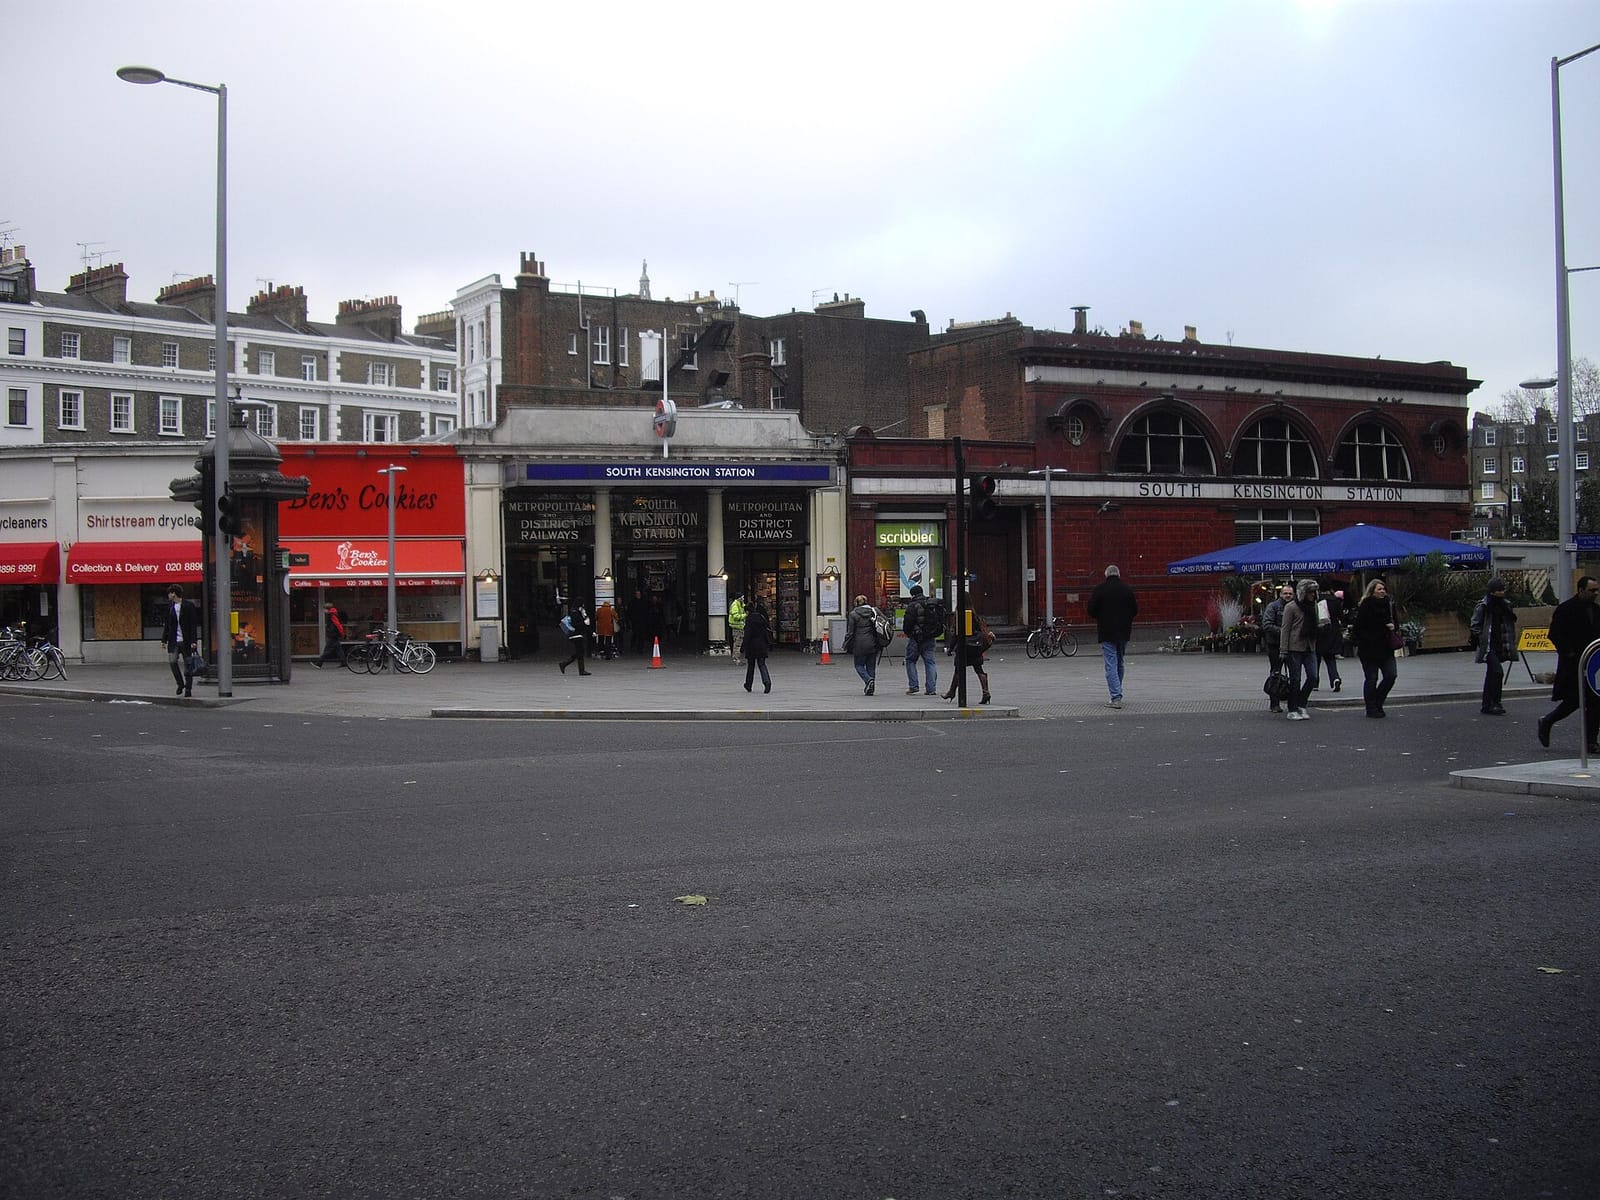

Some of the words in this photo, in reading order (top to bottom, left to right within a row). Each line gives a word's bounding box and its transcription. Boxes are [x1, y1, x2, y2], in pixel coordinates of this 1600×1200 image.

[606, 468, 642, 476] SOUTH
[646, 468, 710, 477] KENSINGTON
[715, 468, 754, 477] STATION
[1139, 482, 1200, 496] SOUTH
[1233, 484, 1322, 499] KENSINGTON
[1347, 488, 1402, 500] STATION
[509, 502, 594, 512] METROPOLITAN
[640, 499, 676, 510] SOUTH
[728, 503, 802, 512] METROPOLITAN
[87, 515, 155, 528] Shirtstream
[620, 512, 698, 526] KENSINGTON
[740, 520, 792, 528] DISTRICT
[520, 520, 578, 529] DISTRICT
[520, 530, 579, 540] RAILWAYS
[632, 528, 684, 539] STATION
[740, 530, 792, 539] RAILWAYS
[880, 528, 934, 544] scribbler
[350, 550, 378, 559] Ben's
[351, 558, 388, 566] Cookies
[1242, 564, 1263, 572] QUALITY
[1266, 563, 1290, 571] FLOWERS
[1291, 562, 1307, 570] FROM
[1308, 561, 1336, 570] HOLLAND
[18, 564, 36, 572] 9991
[72, 564, 112, 572] Collection
[115, 564, 122, 572] &
[125, 563, 159, 574] Delivery
[165, 562, 182, 571] 020
